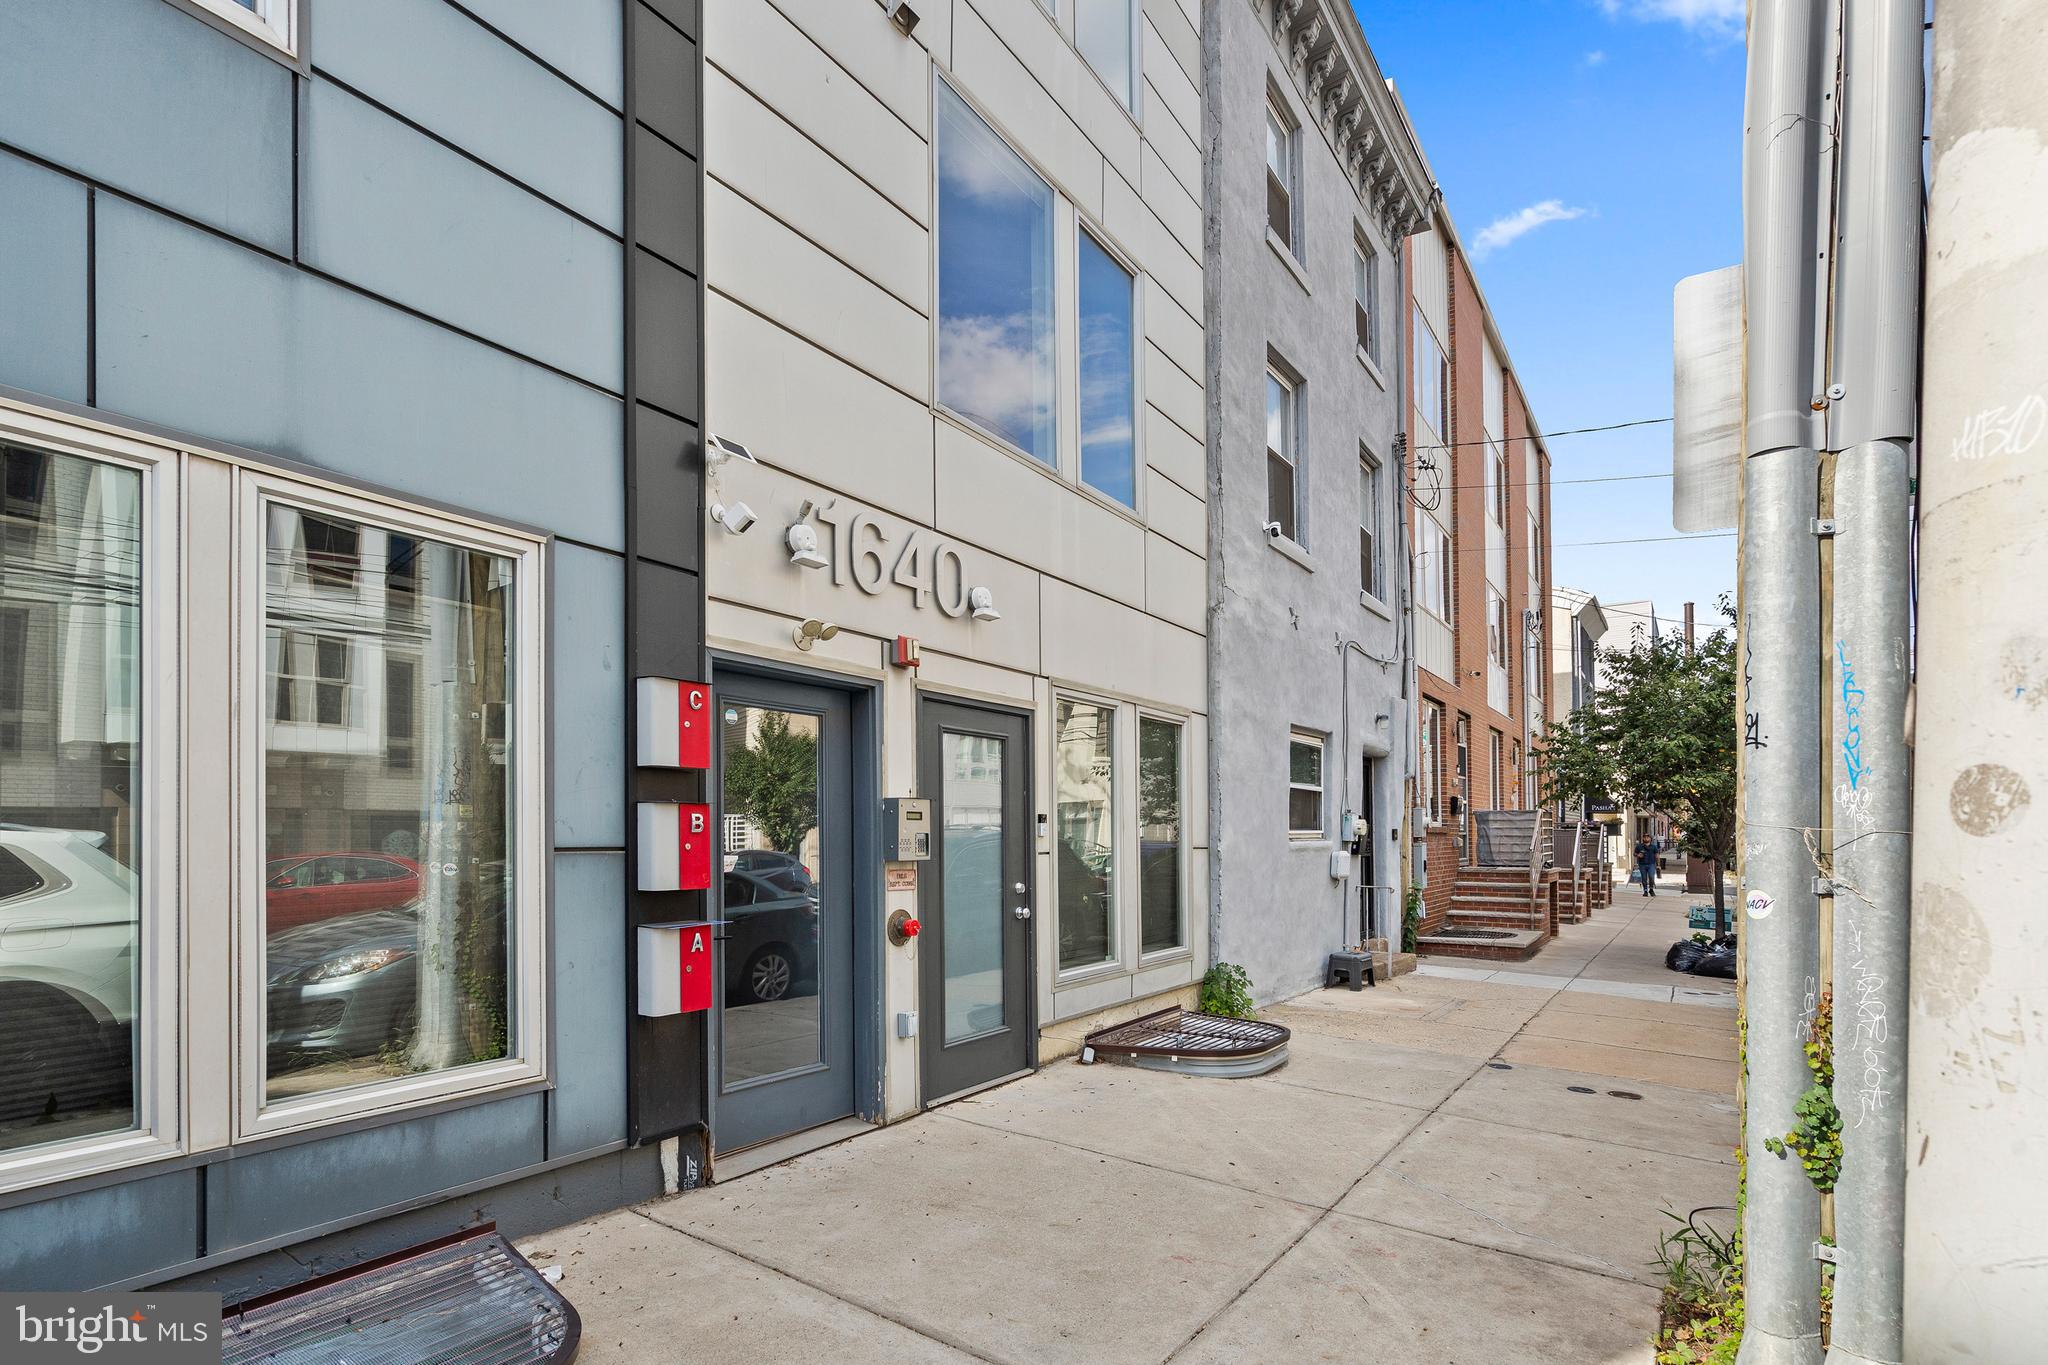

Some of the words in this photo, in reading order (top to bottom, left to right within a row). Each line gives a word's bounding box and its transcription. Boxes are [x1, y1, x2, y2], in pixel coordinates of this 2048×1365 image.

[816, 498, 968, 618] 1640
[689, 690, 703, 711] C
[690, 813, 704, 833] B
[690, 932, 704, 953] A
